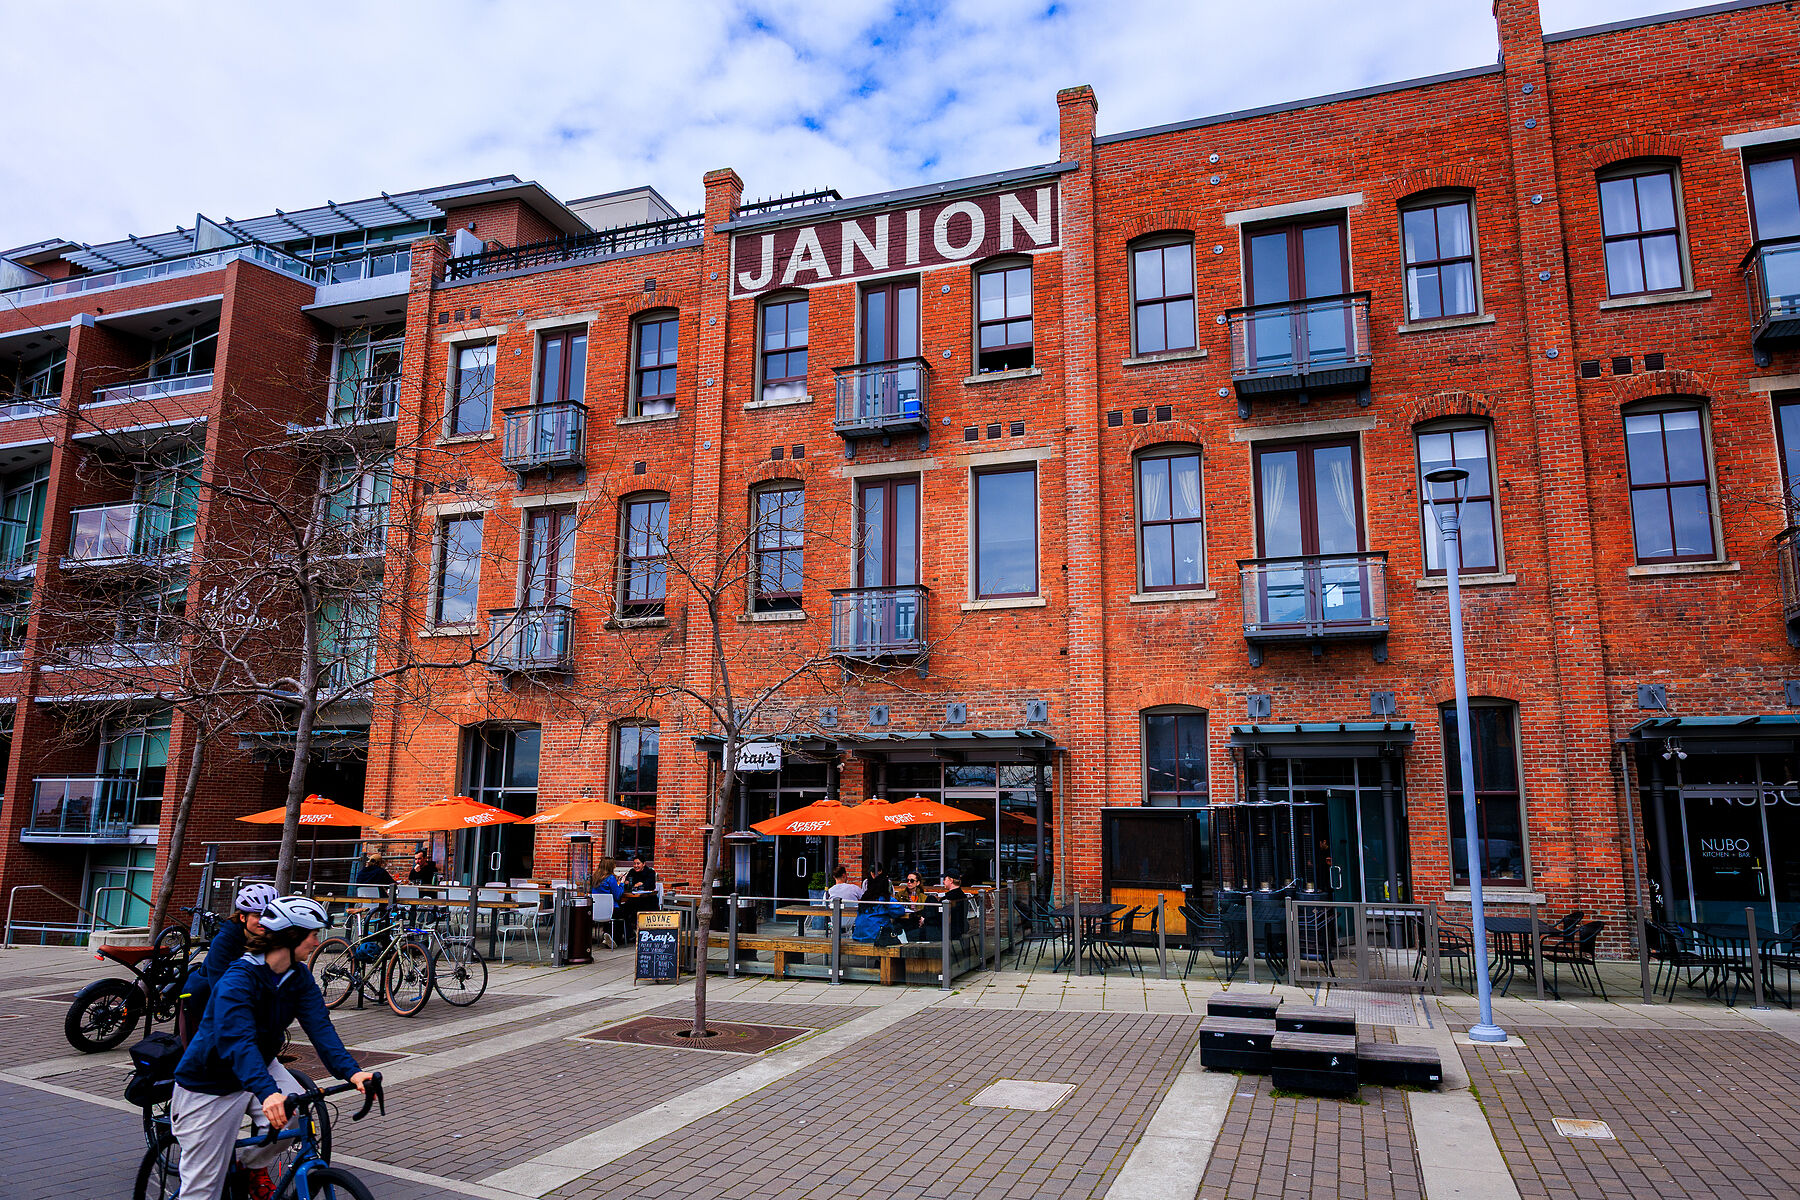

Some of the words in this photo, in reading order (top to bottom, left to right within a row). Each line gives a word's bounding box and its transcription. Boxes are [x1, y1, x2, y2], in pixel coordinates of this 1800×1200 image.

[738, 187, 1053, 291] JANION
[200, 609, 281, 631] NDORA
[785, 820, 832, 830] APEROL
[791, 825, 823, 833] SPRITZ
[1700, 838, 1750, 851] NUBO
[646, 915, 672, 923] HOYNE
[640, 931, 676, 944] Bray's
